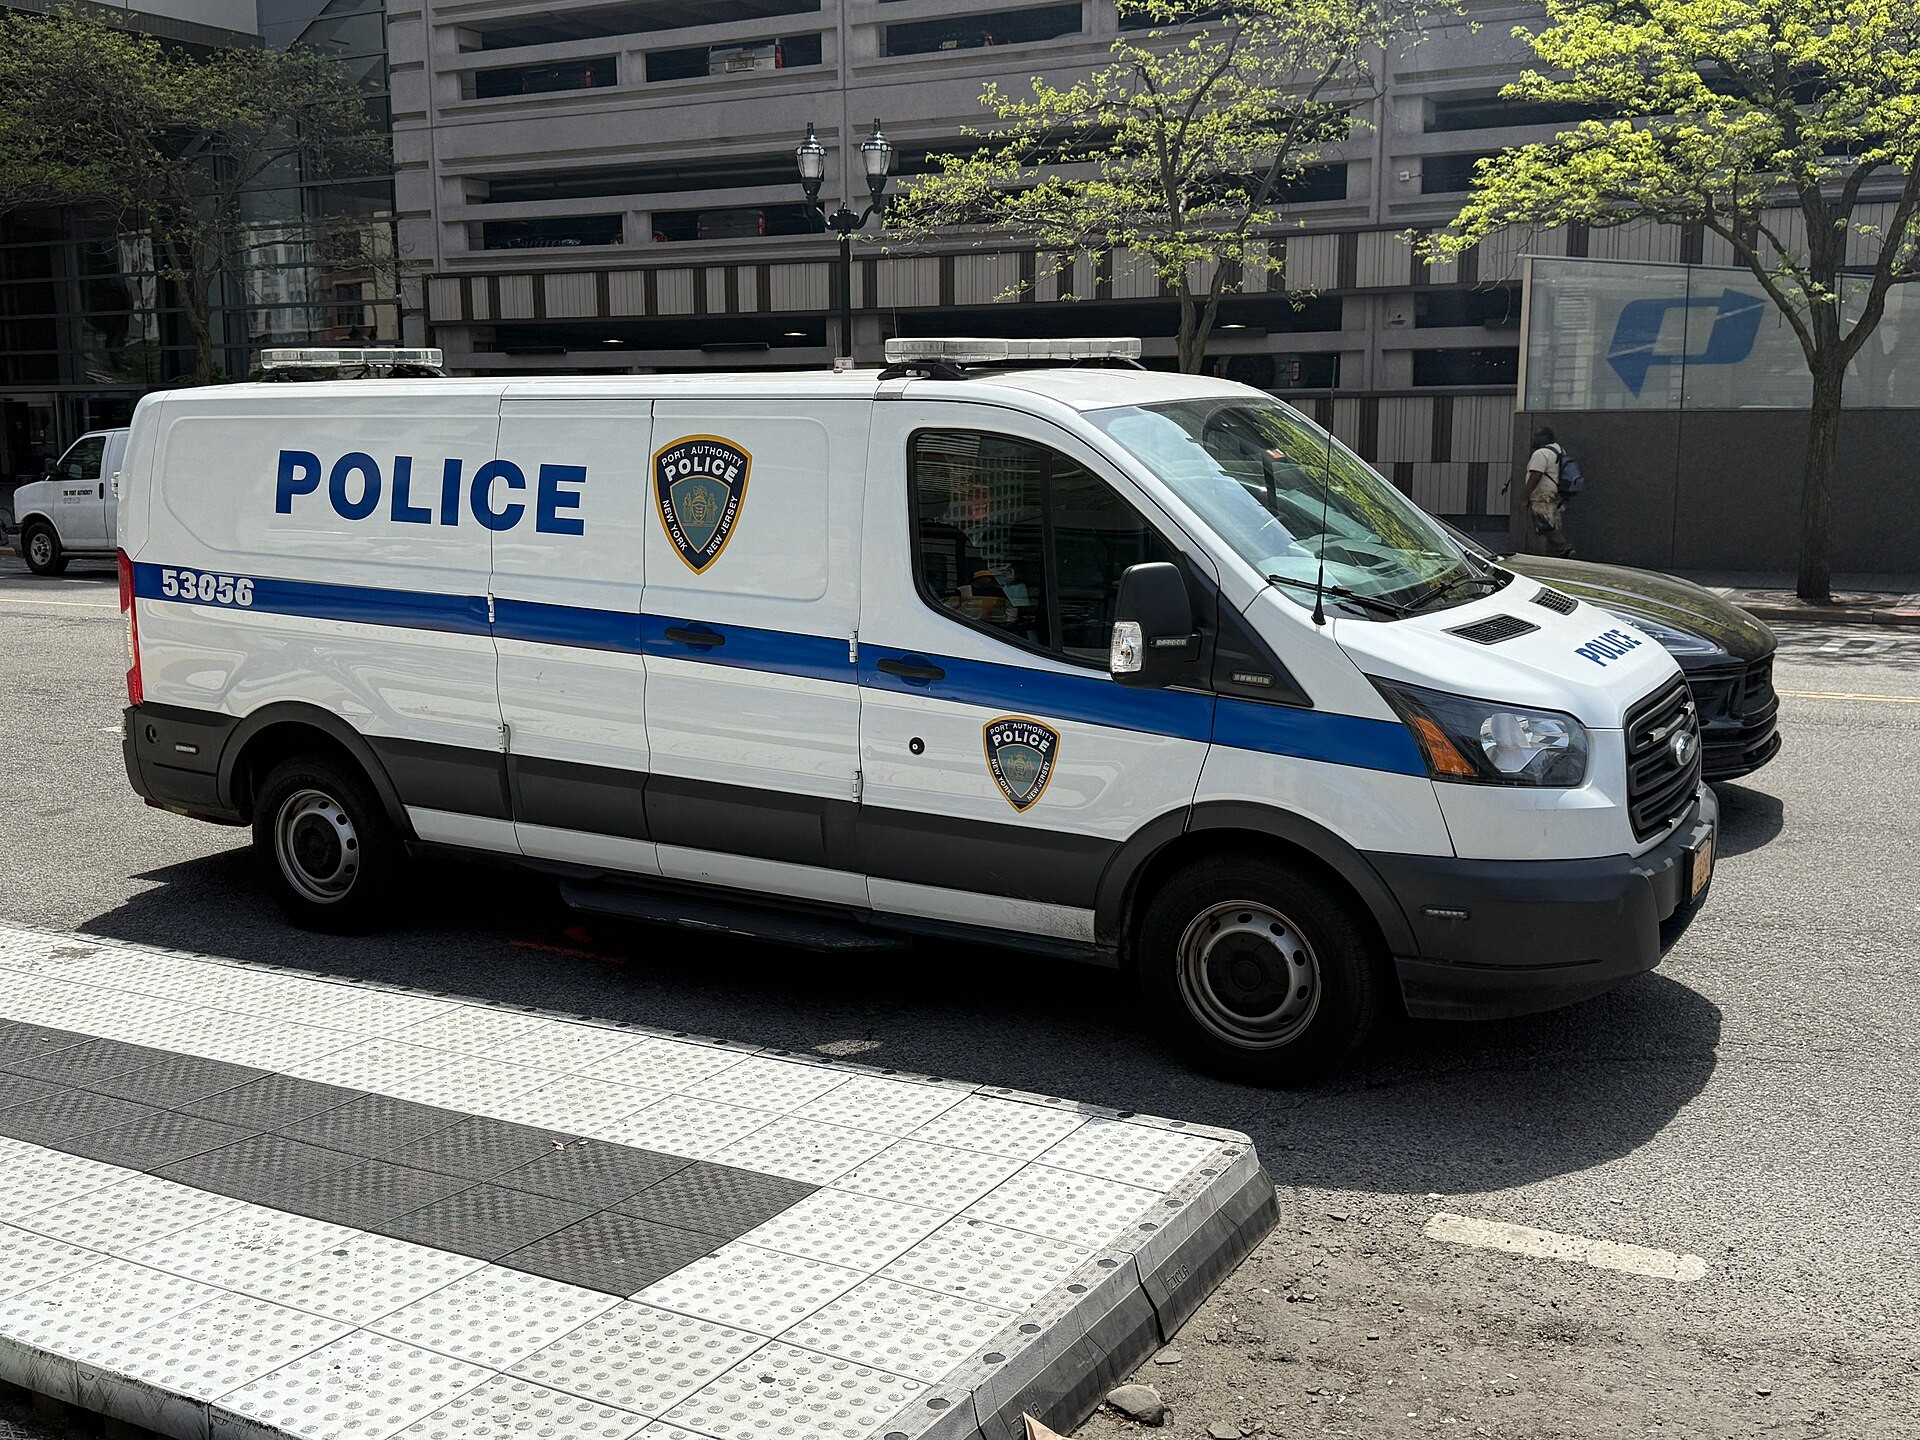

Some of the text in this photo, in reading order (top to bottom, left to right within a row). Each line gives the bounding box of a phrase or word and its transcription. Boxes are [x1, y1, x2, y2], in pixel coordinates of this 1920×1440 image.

[661, 445, 744, 467] PORT AUTHORITY
[664, 456, 739, 484] POLICE
[275, 449, 588, 537] POLICE
[662, 499, 689, 552] NEW YORK
[706, 495, 739, 556] NEW JERSEY
[162, 568, 255, 607] 53056
[1574, 628, 1643, 667] POLICE
[989, 722, 1054, 742] PORT AUTHORITY
[992, 730, 1050, 753] POLICE
[991, 758, 1013, 796] NEW YORK
[1026, 760, 1051, 801] NEW JERSEY
